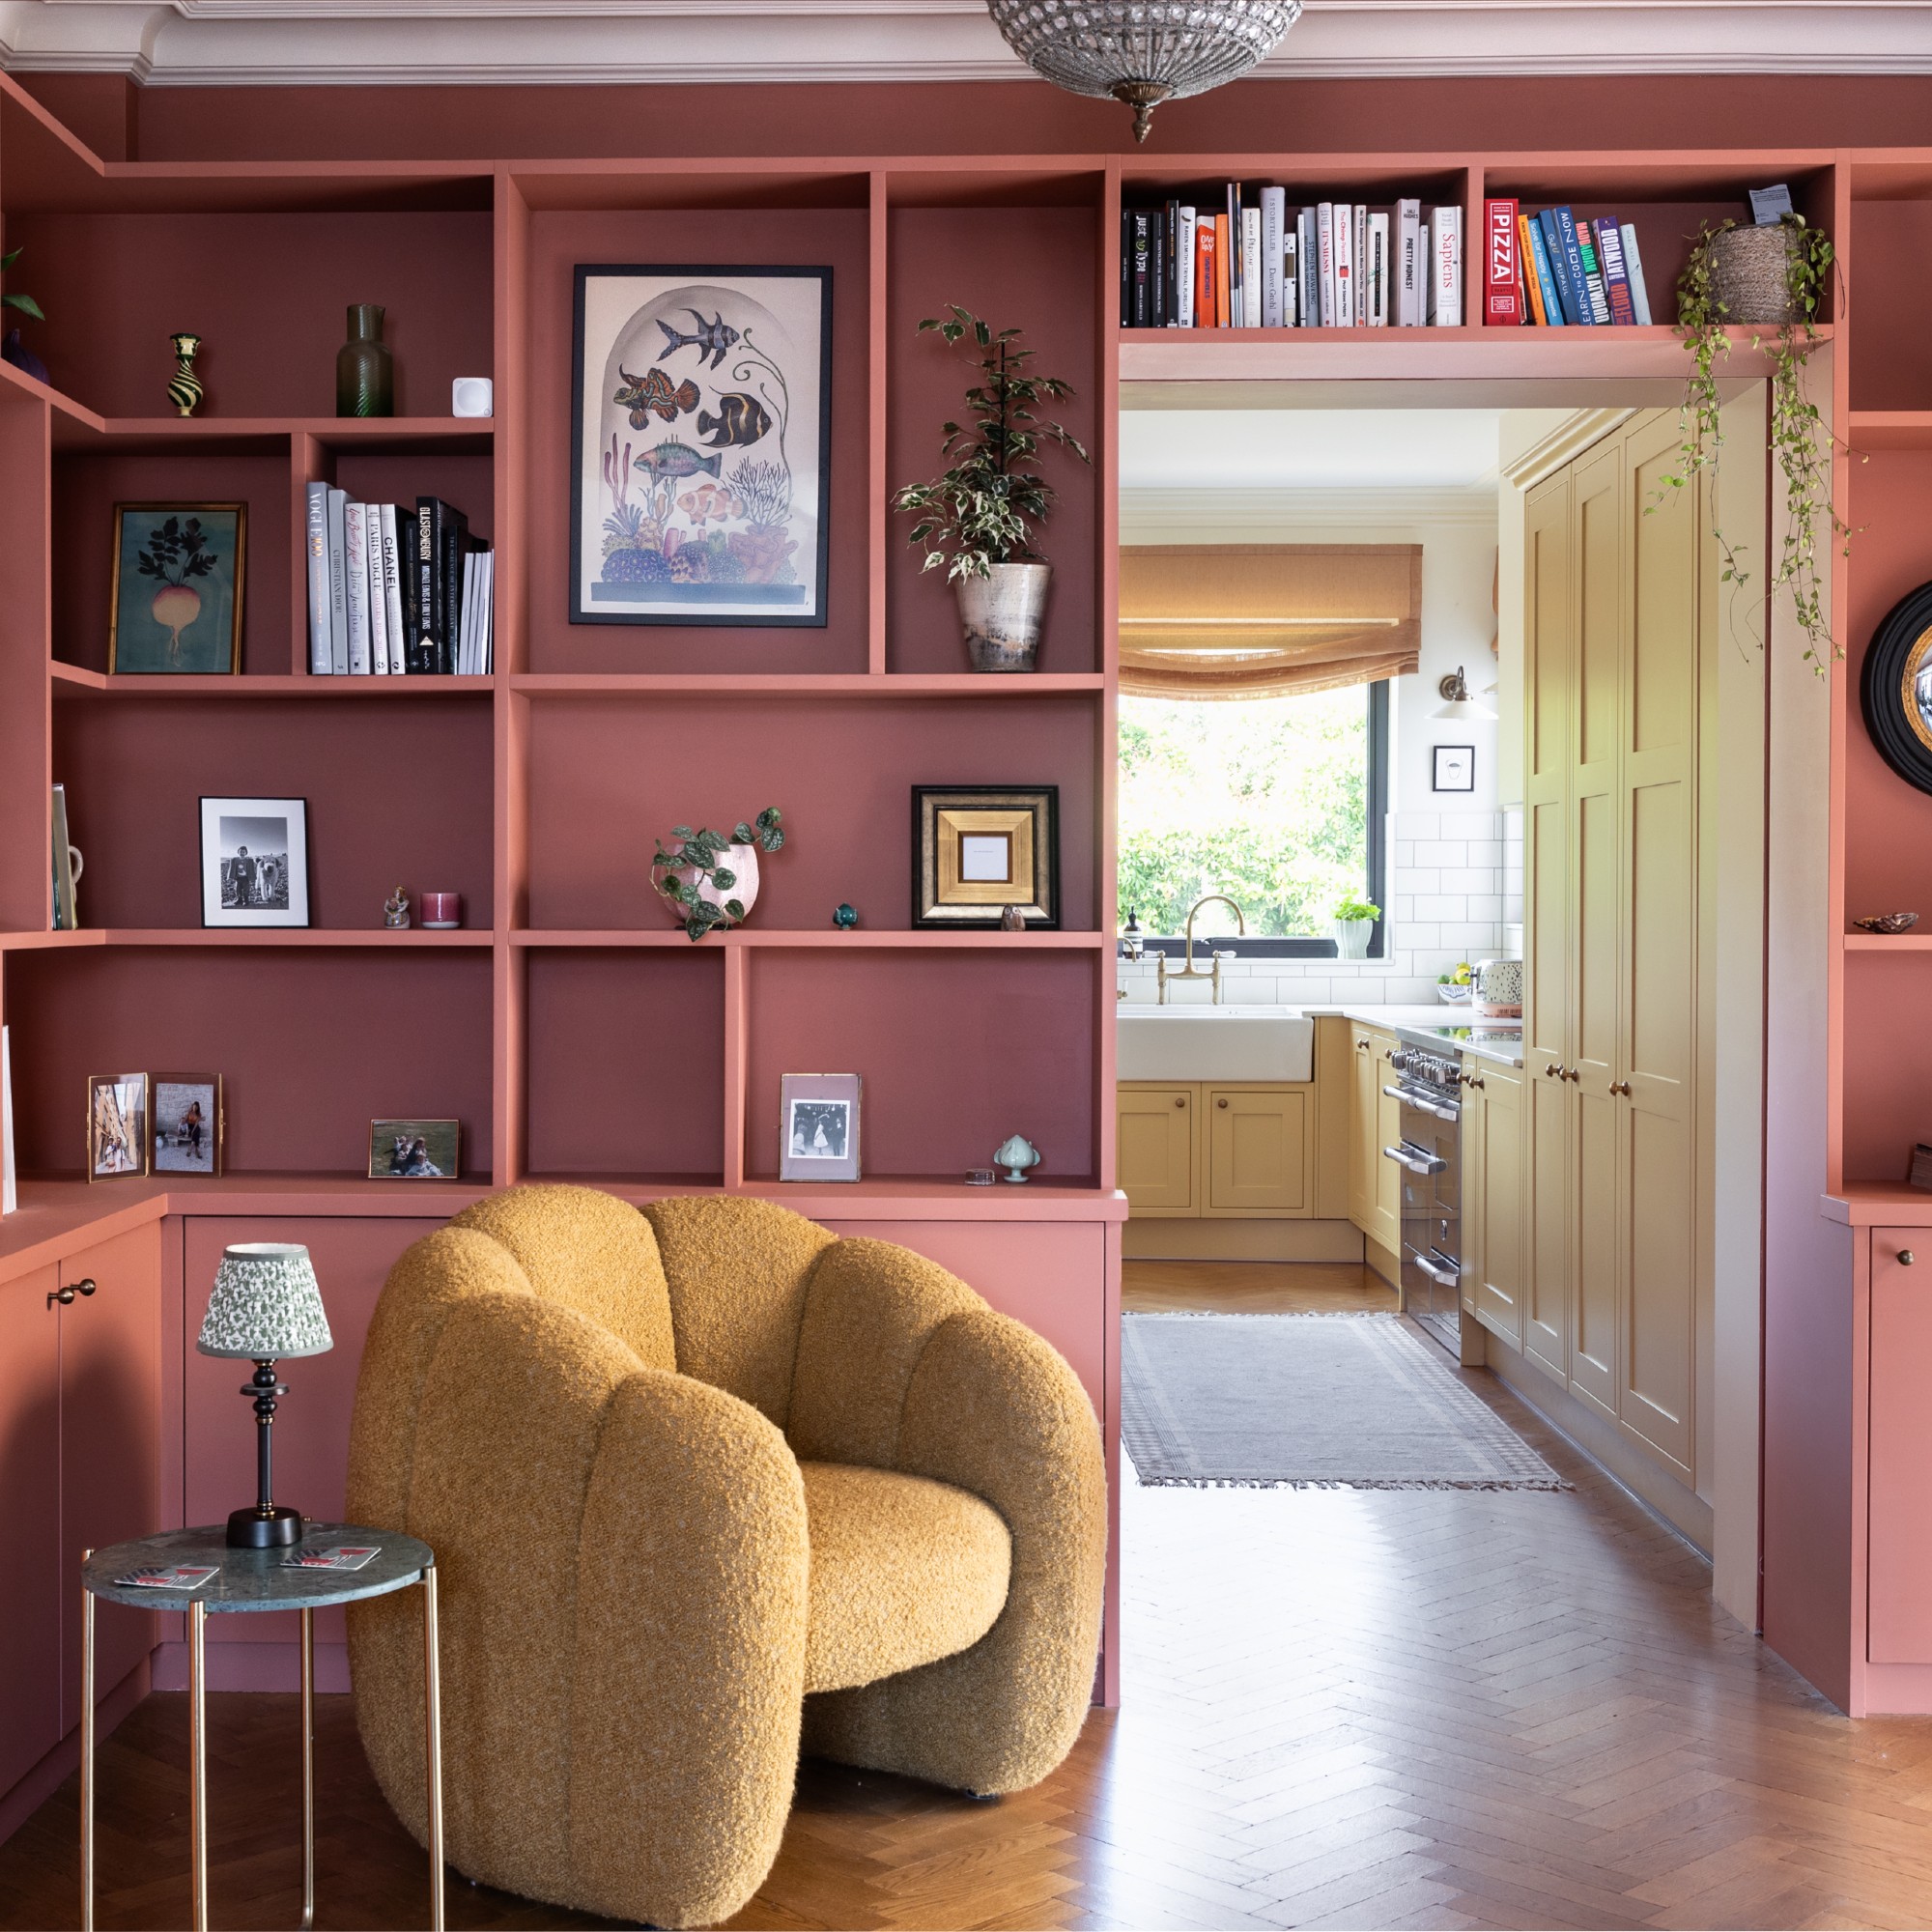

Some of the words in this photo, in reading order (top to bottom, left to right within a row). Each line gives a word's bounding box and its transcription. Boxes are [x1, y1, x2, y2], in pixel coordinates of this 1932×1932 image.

[1561, 213, 1574, 242] NOW
[1136, 251, 1148, 271] Type
[1439, 234, 1455, 288] Sapiens
[1493, 214, 1510, 279] PIZZA
[1530, 222, 1539, 242] Solve
[1537, 252, 1547, 273] Happy
[1568, 246, 1581, 278] CODE
[1576, 221, 1597, 272] MADDADDAM
[1601, 228, 1624, 273] ATWOOD
[1546, 287, 1551, 296] Mo
[1556, 263, 1568, 296] RUPAUL
[1586, 279, 1609, 323] ATWOOD
[1610, 283, 1632, 317] FLOOD
[370, 524, 380, 554] PARIS
[419, 507, 431, 560] GLASTONBURY
[371, 556, 381, 591] VOGUE
[384, 537, 396, 593] CHANEL
[422, 603, 431, 615] EMILY
[422, 617, 431, 629] EAVIS
